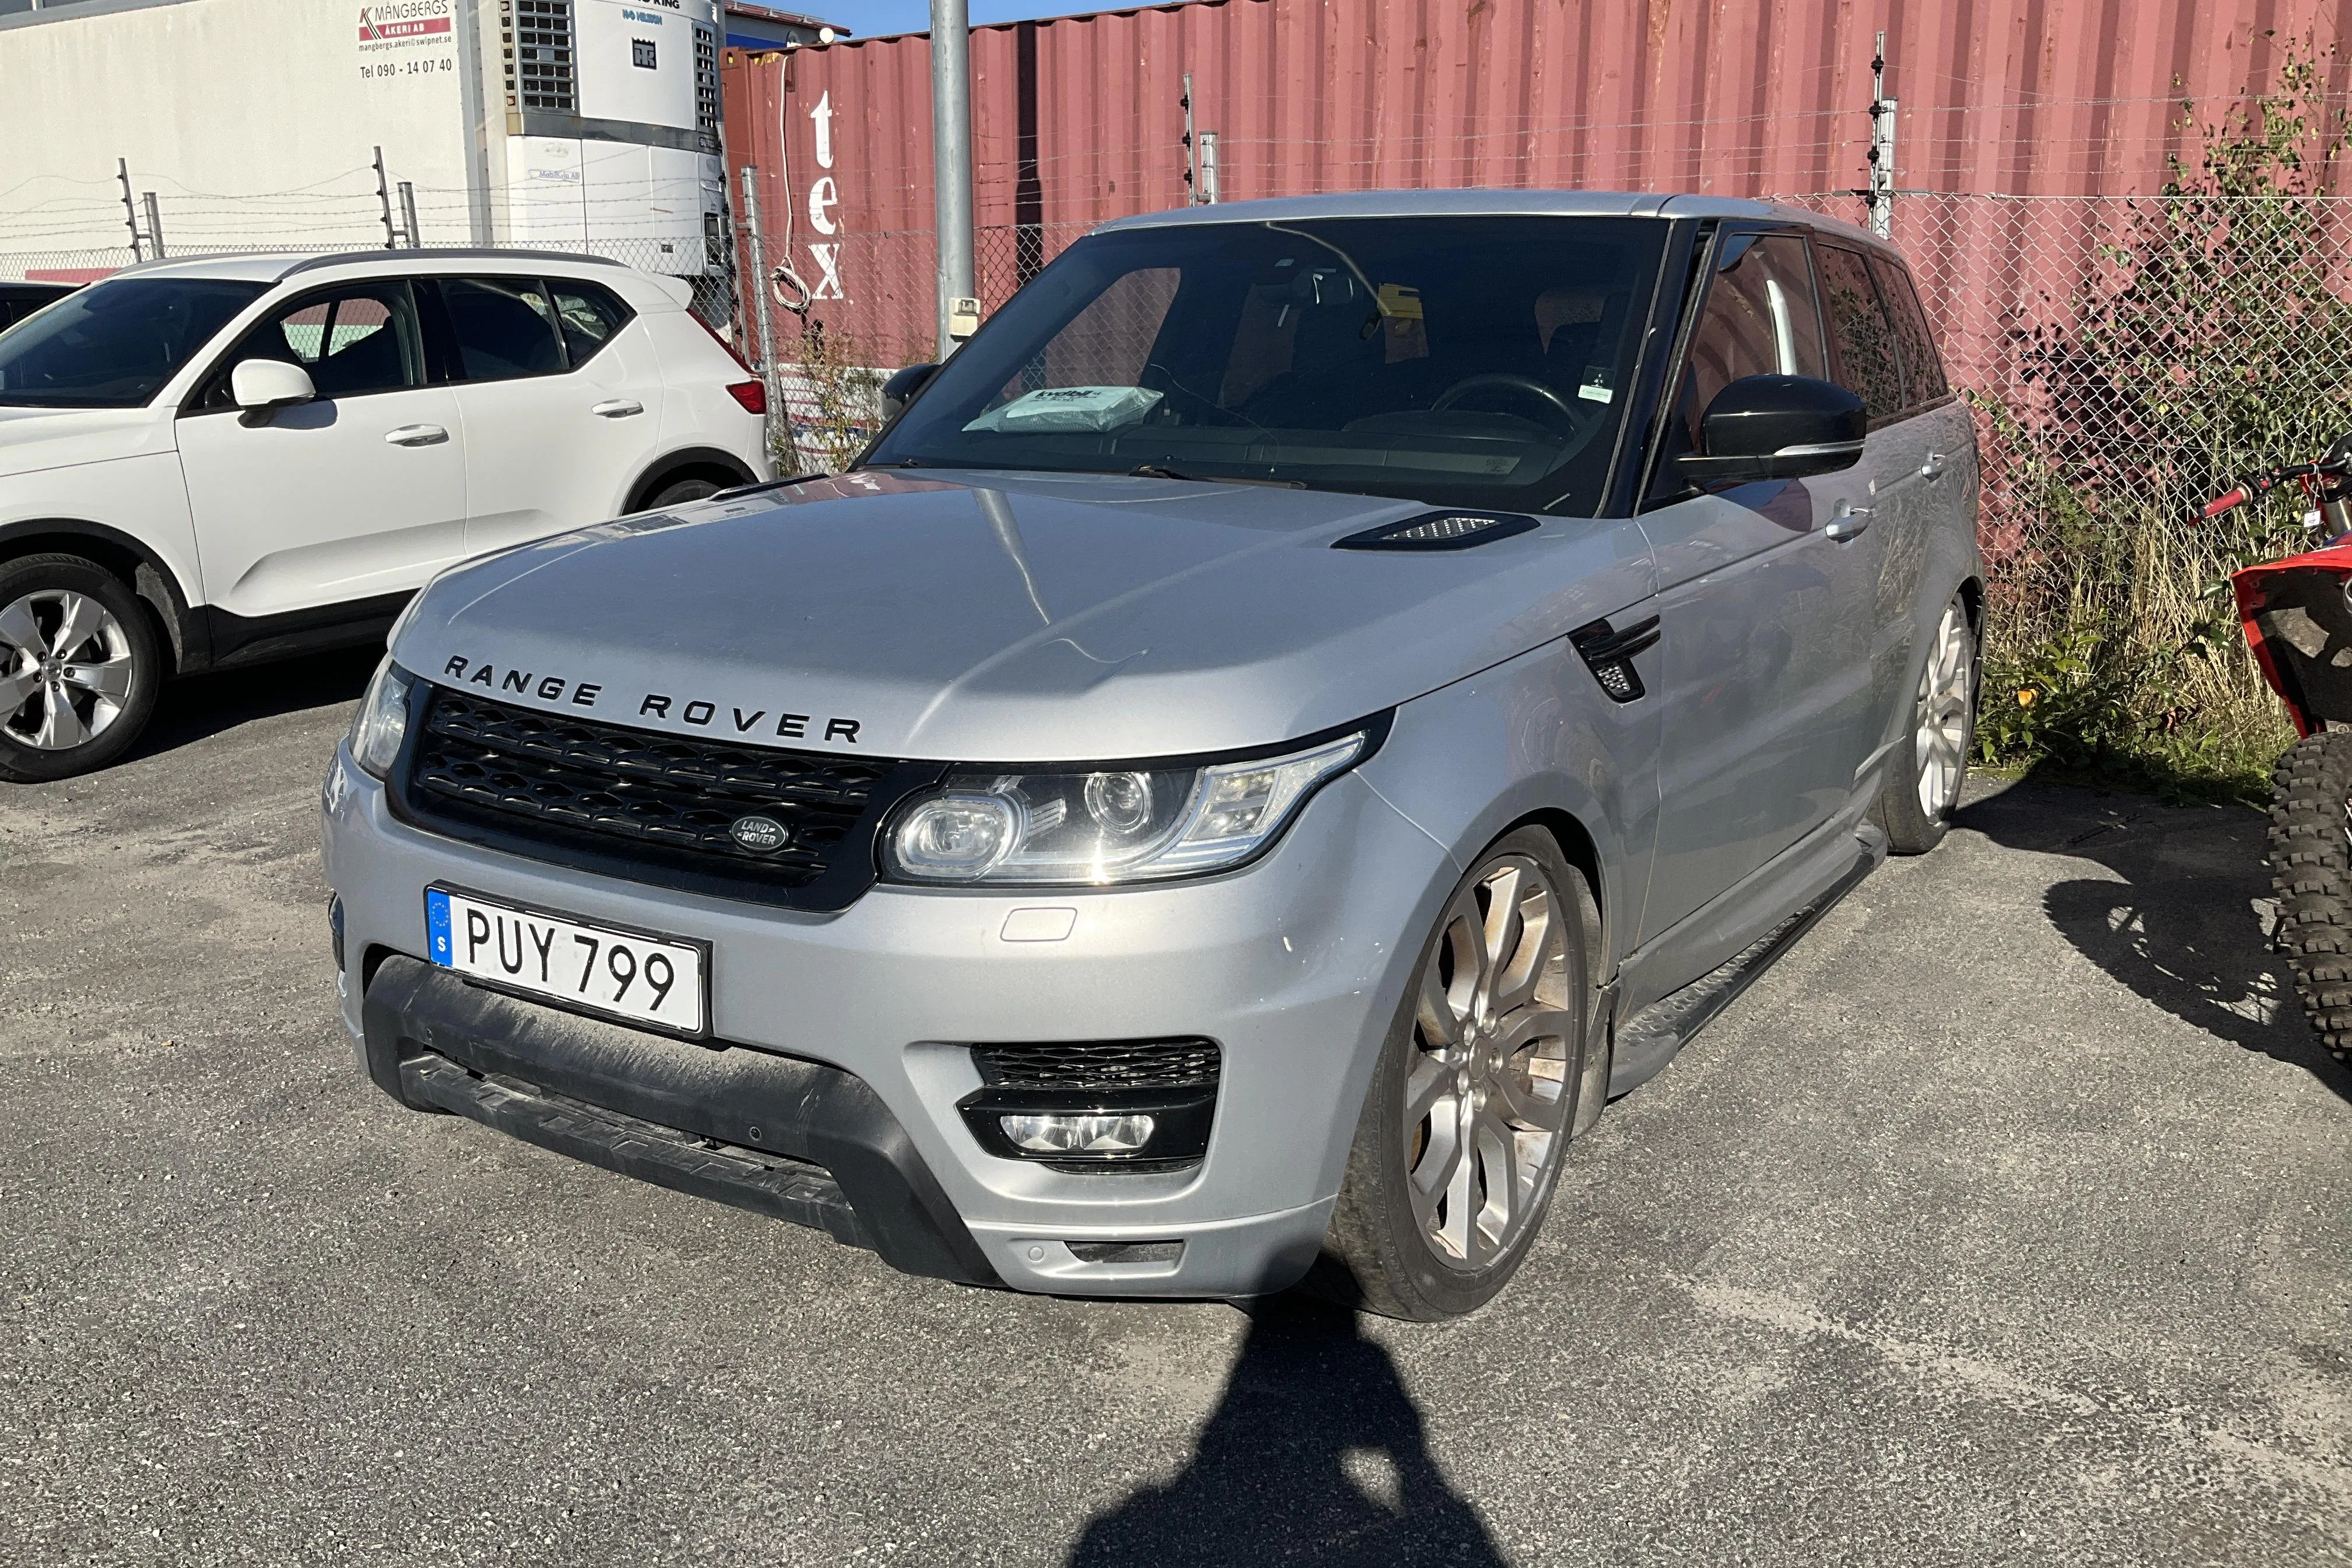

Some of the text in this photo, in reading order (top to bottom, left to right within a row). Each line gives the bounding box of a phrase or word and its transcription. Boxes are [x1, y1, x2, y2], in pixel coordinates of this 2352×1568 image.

[375, 0, 448, 21] MÅNGBERGS
[385, 23, 424, 36] ÅKERI AB
[360, 65, 374, 79] Tel
[377, 64, 395, 77] 090
[407, 62, 418, 74] 14
[423, 60, 435, 73] 07
[439, 58, 452, 71] 40
[808, 90, 844, 299] tex
[444, 655, 860, 744] RANGE ROVER
[741, 821, 769, 833] LAND
[741, 831, 776, 845] ROVER
[438, 936, 446, 952] S
[467, 908, 675, 1012] PUY 799
